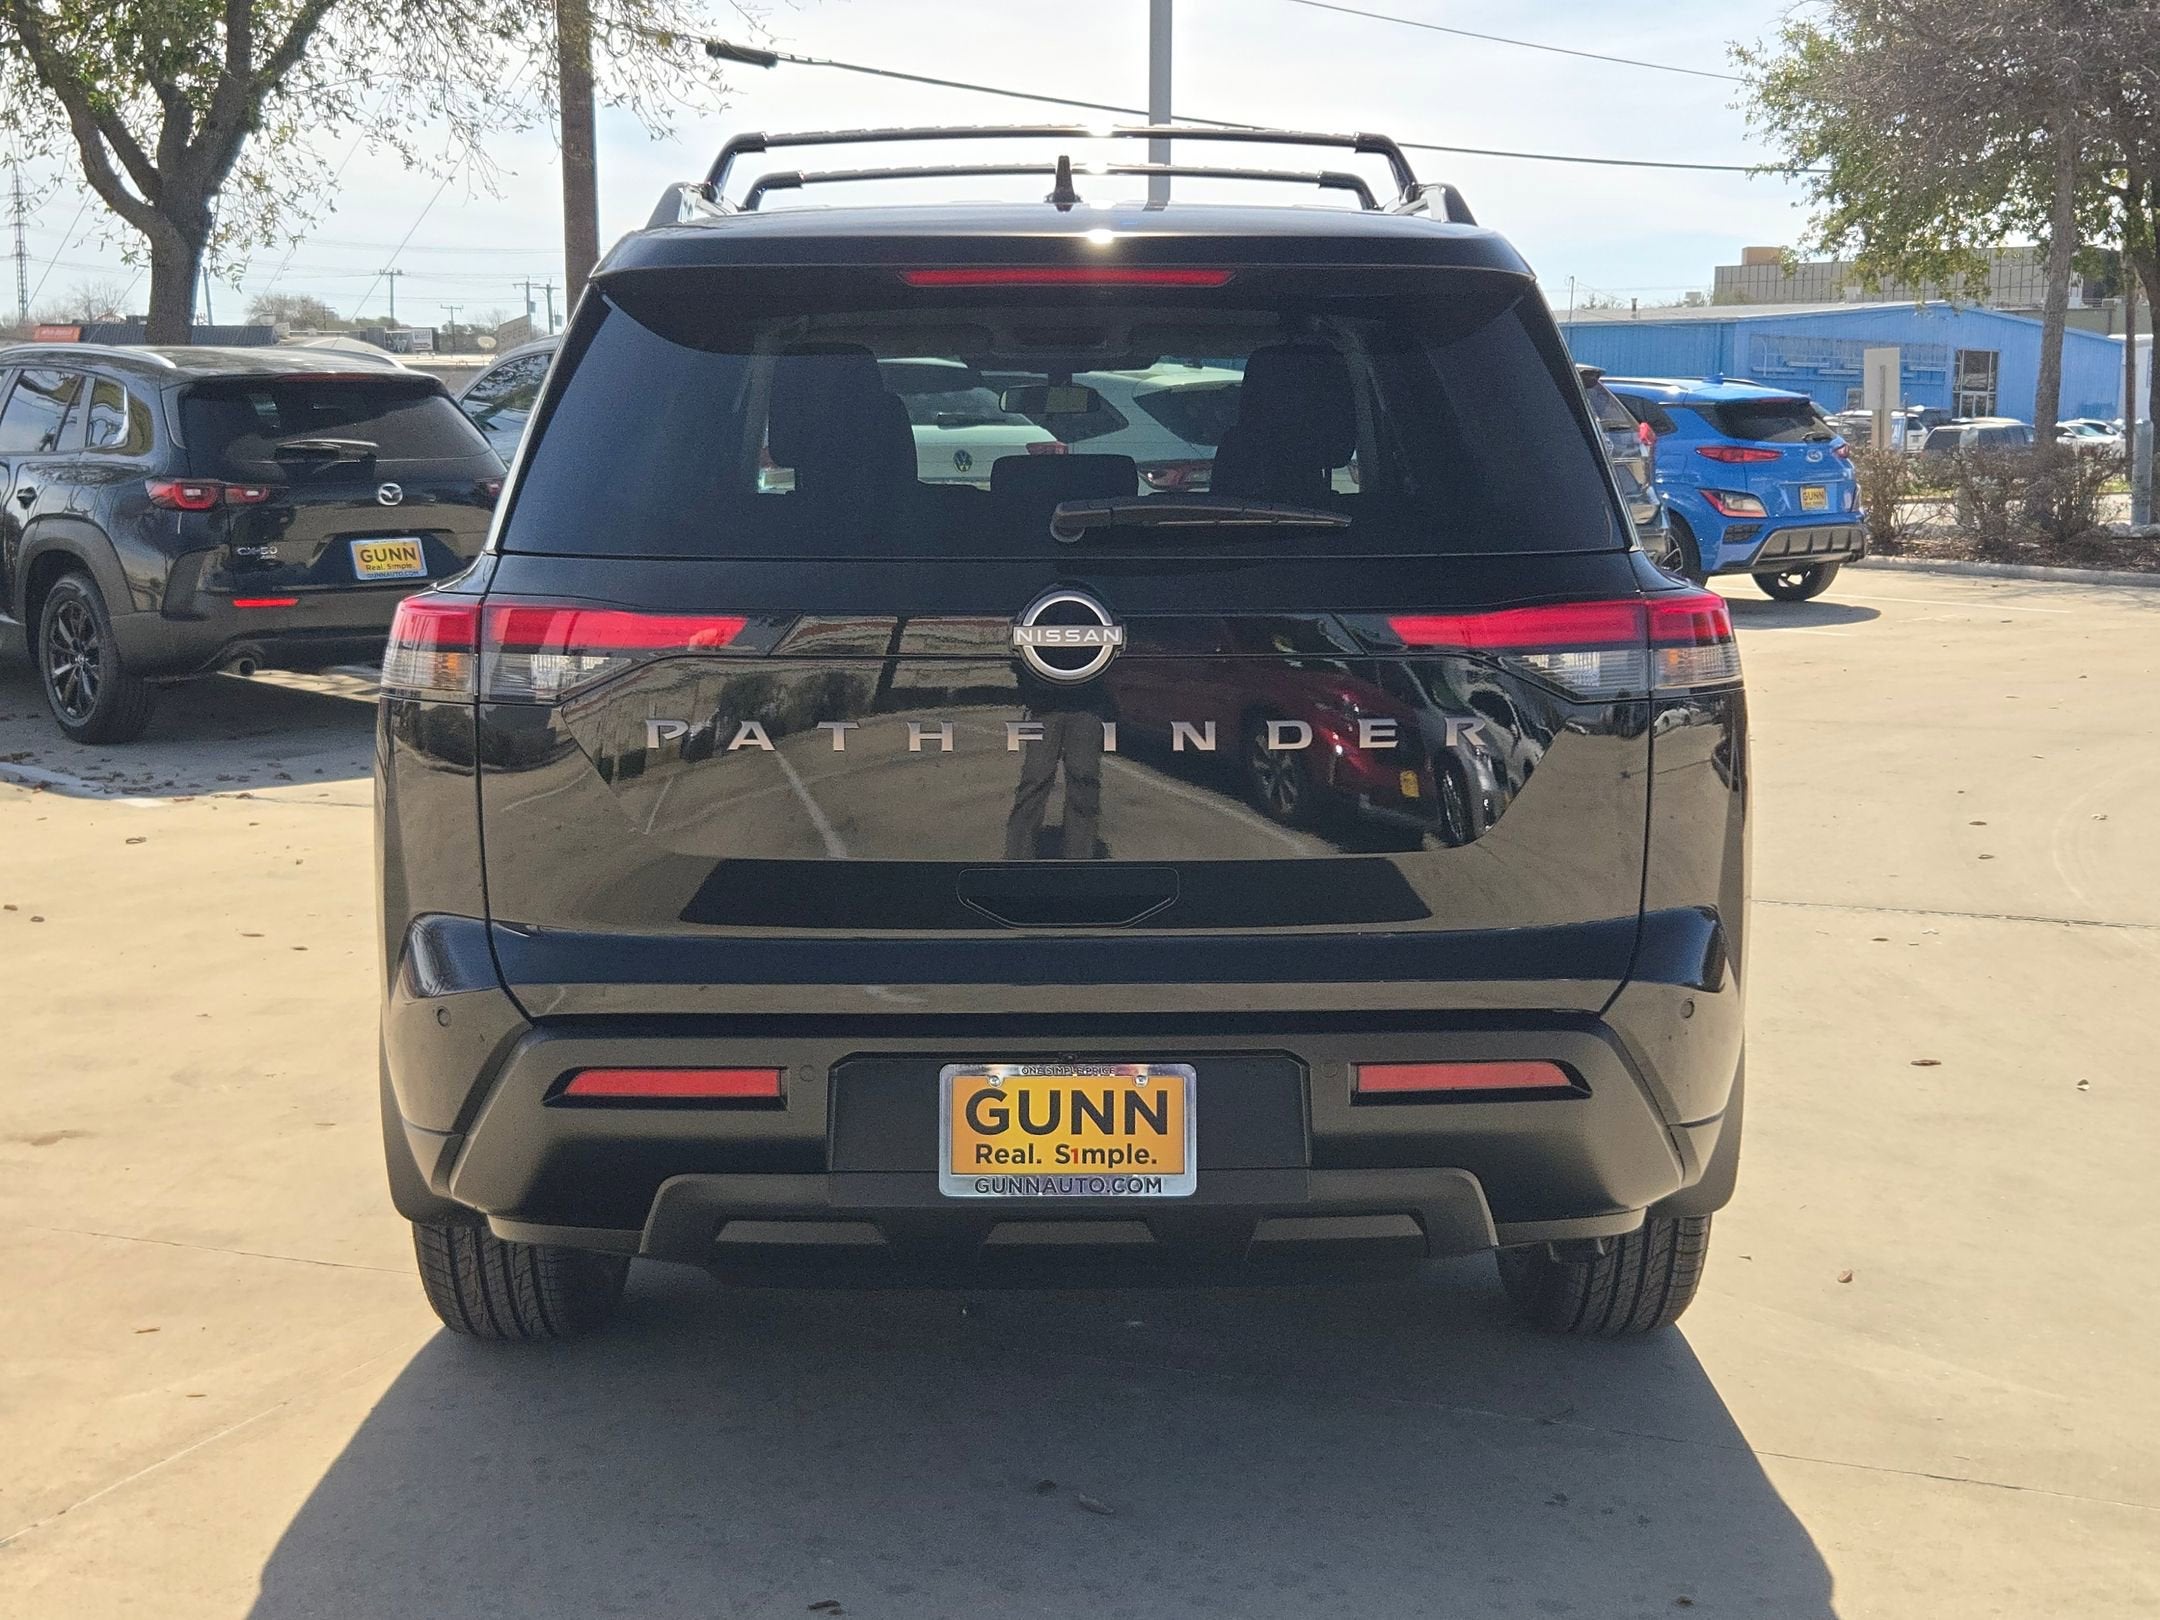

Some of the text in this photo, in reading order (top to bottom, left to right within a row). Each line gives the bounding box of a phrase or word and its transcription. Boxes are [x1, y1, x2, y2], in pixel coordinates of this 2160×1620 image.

[360, 547, 417, 563] GUNN
[1016, 628, 1119, 643] NISSAN
[645, 718, 1489, 752] PATHFINDER
[1021, 1066, 1045, 1075] ONE
[965, 1088, 1168, 1136] GUNN
[975, 1143, 1042, 1165] Real.
[974, 1177, 1162, 1195] GUNNAUTO.COM
